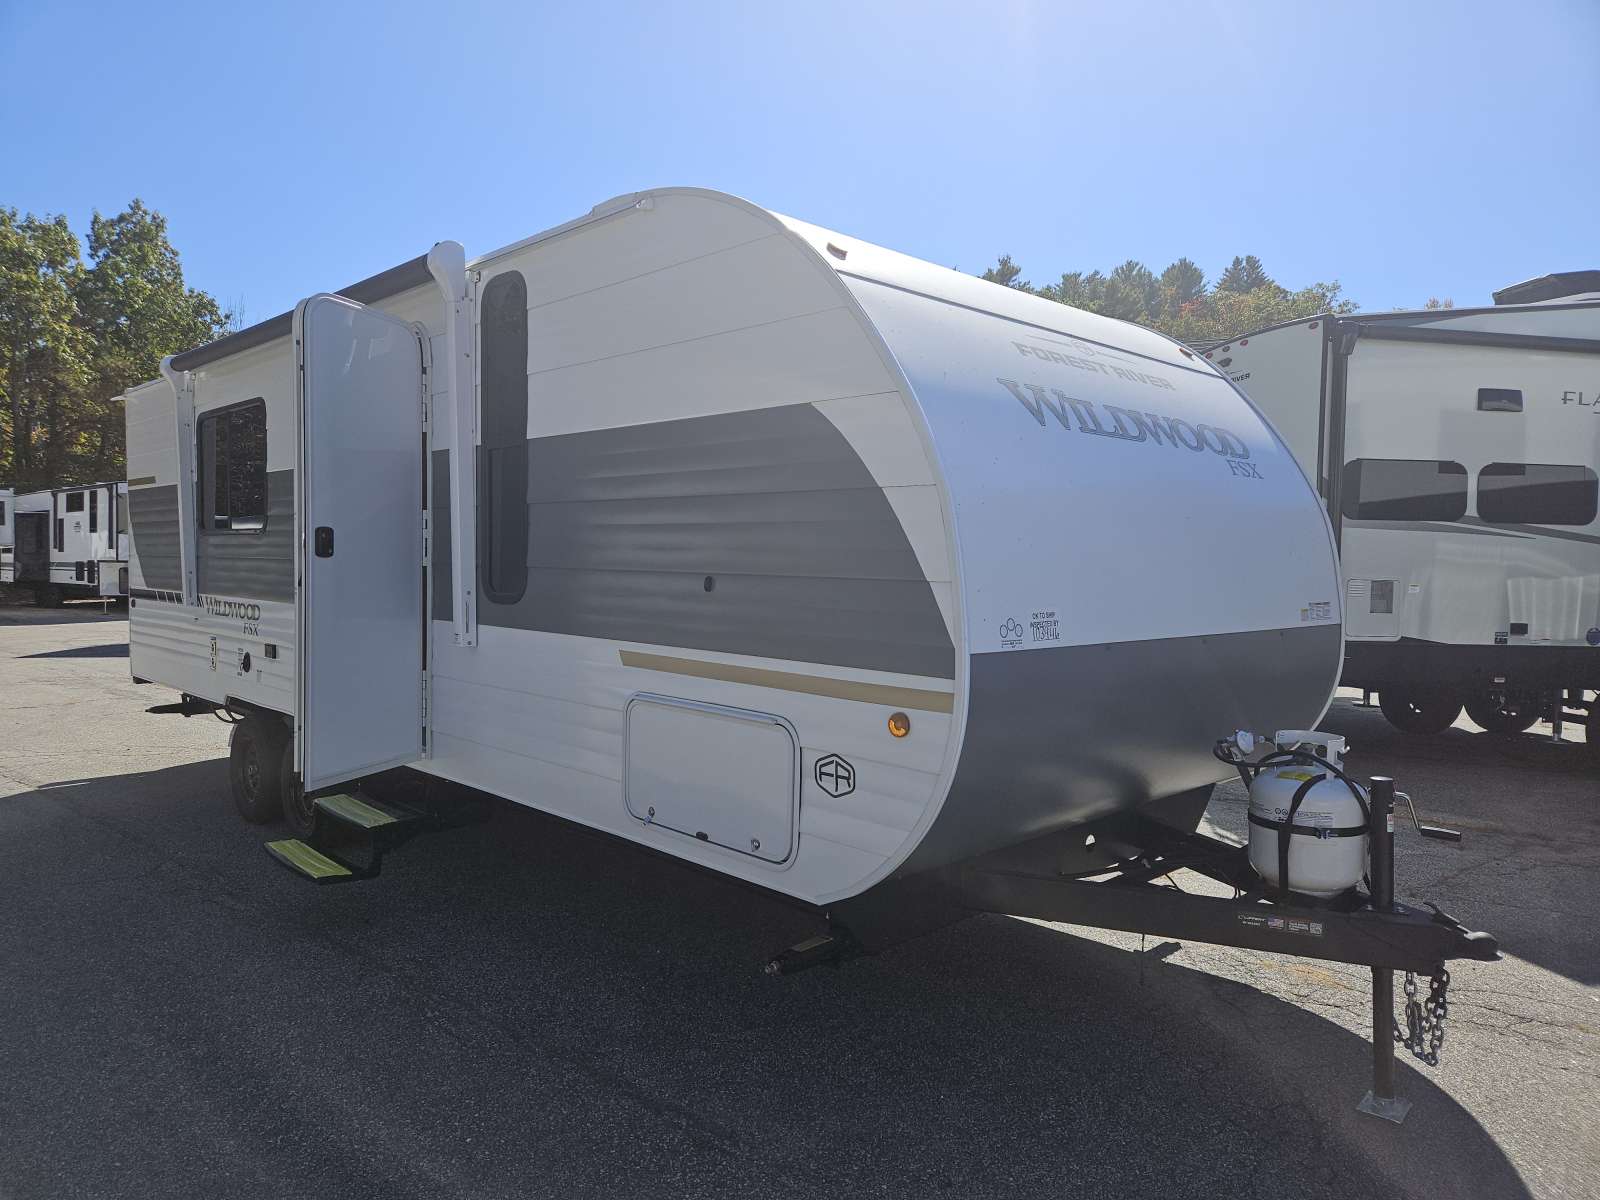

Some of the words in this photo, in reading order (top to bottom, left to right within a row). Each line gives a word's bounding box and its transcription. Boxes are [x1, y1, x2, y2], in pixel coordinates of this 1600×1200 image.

[1011, 341, 1109, 375] FOREST
[1110, 365, 1176, 391] RIVER
[997, 377, 1250, 460] WILDWOOD
[1226, 459, 1265, 480] FSX
[205, 596, 260, 621] WILDWOOD
[243, 622, 259, 636] FSX
[818, 759, 852, 793] FR
